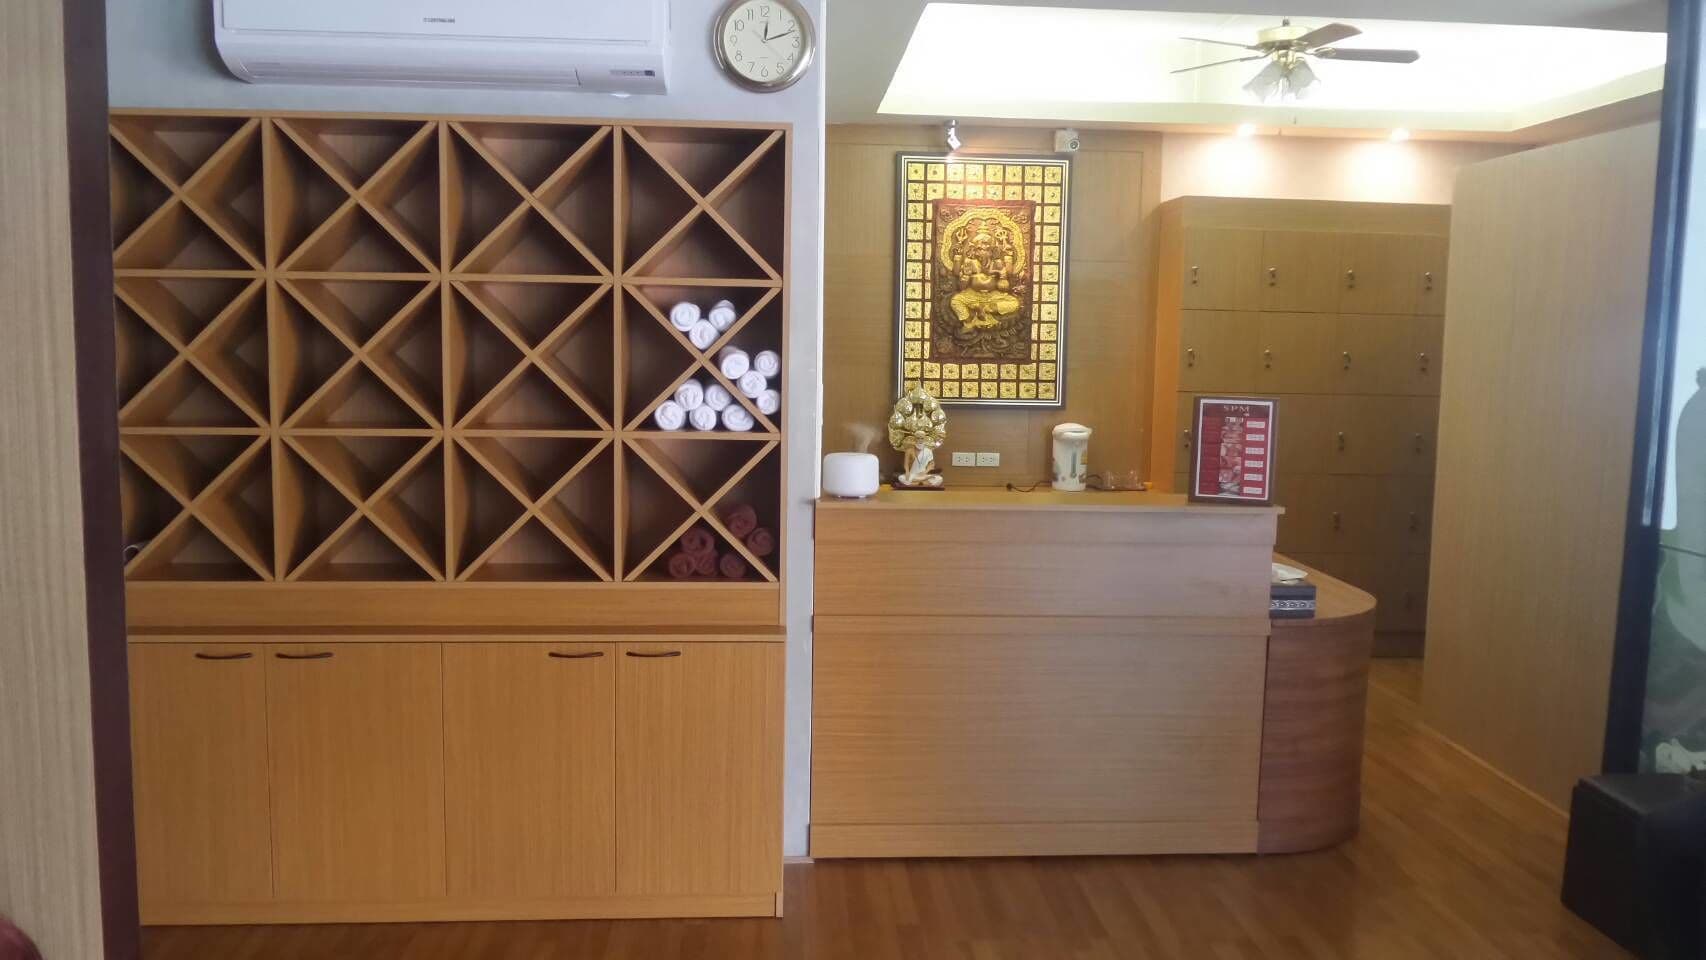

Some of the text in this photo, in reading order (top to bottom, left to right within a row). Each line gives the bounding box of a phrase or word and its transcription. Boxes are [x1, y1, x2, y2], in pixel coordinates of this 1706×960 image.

[747, 9, 754, 21] 11
[760, 6, 769, 17] 12
[734, 19, 744, 31] 10
[786, 20, 794, 31] 2
[731, 35, 737, 46] 9
[792, 36, 800, 48] 3
[735, 50, 743, 62] 8
[786, 52, 794, 63] 4
[747, 62, 754, 72] 7
[761, 65, 768, 77] 6
[776, 62, 784, 74] 5
